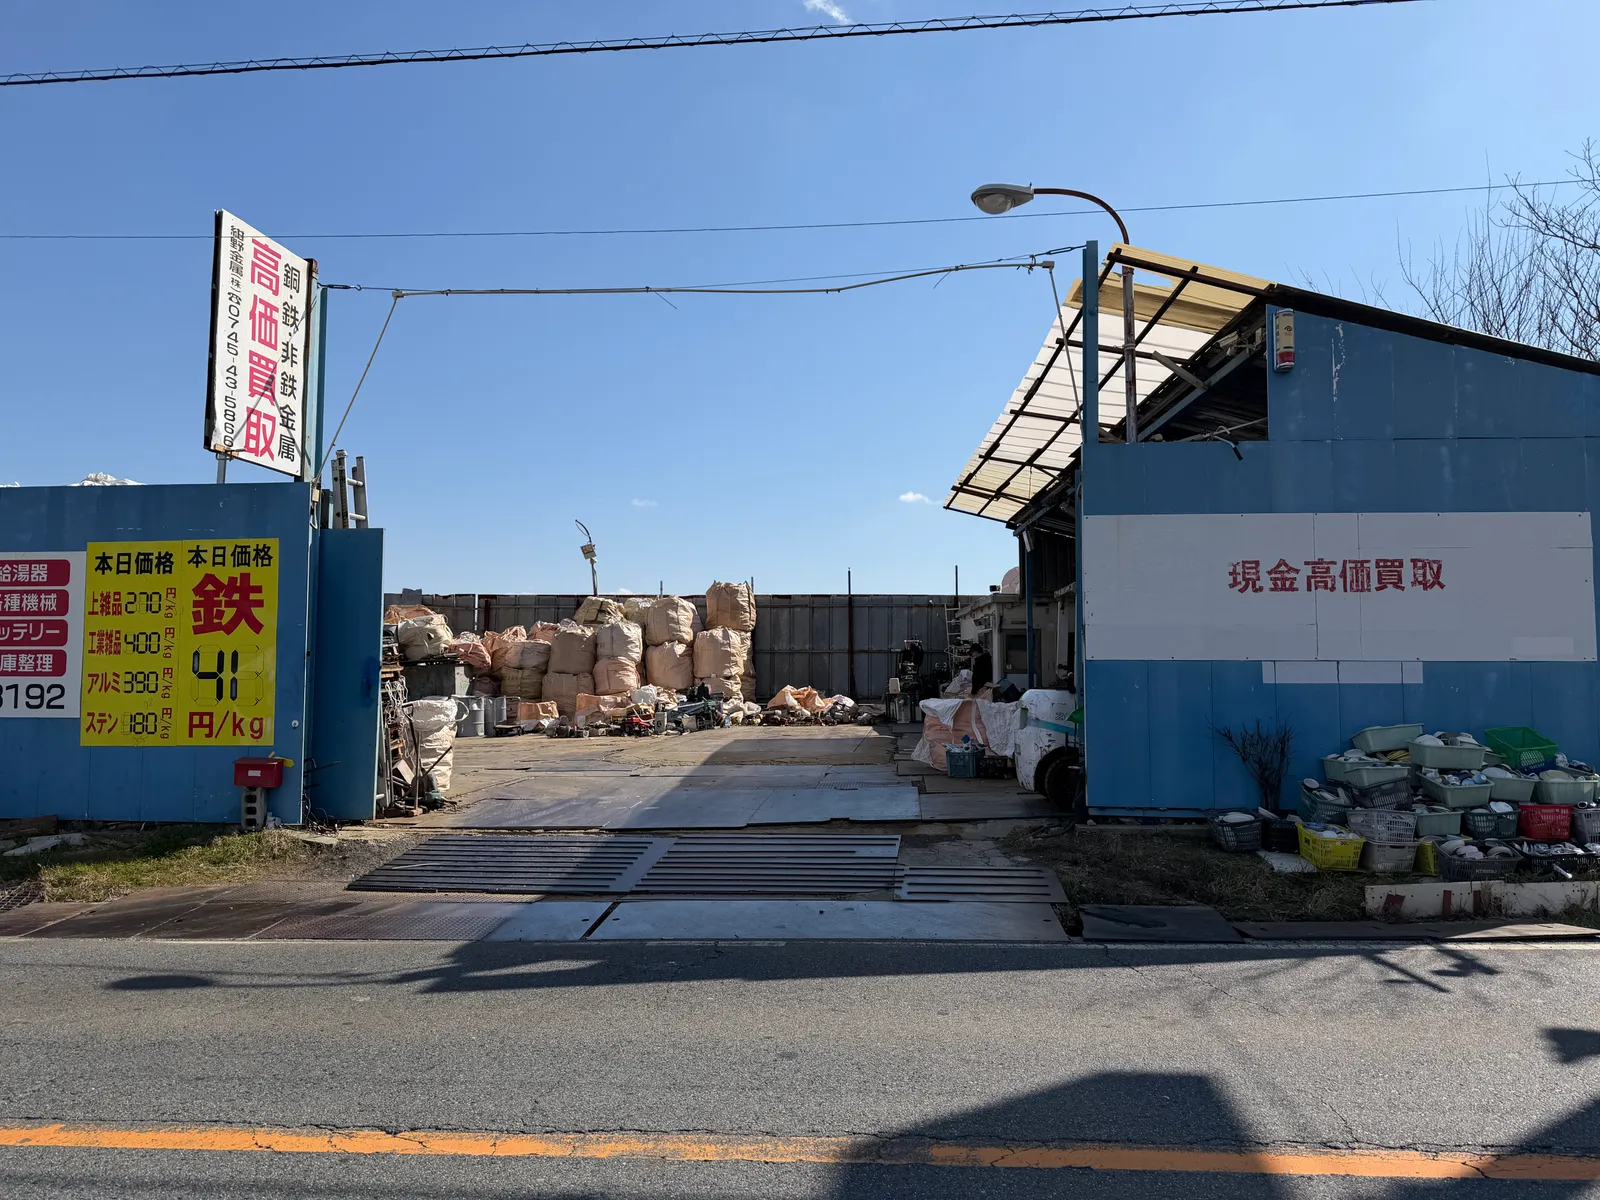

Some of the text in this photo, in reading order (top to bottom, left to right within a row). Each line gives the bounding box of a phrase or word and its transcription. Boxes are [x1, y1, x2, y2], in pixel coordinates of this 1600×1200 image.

[244, 237, 282, 462] 高価買取
[94, 551, 174, 576] 本日価格
[187, 543, 273, 568] 本日価格
[1228, 558, 1446, 593] 現金高価買取
[0, 593, 57, 612] 種機械
[88, 591, 122, 616] 上雑品
[125, 592, 162, 614] 270
[192, 572, 265, 636] 鉄
[124, 632, 160, 654] 400
[87, 671, 121, 694] アルミ
[124, 671, 159, 694] 390
[192, 650, 239, 701] 41
[0, 683, 65, 709] 192
[86, 712, 119, 734] ステン
[129, 712, 157, 734] 180
[188, 710, 264, 739] 円/kg
